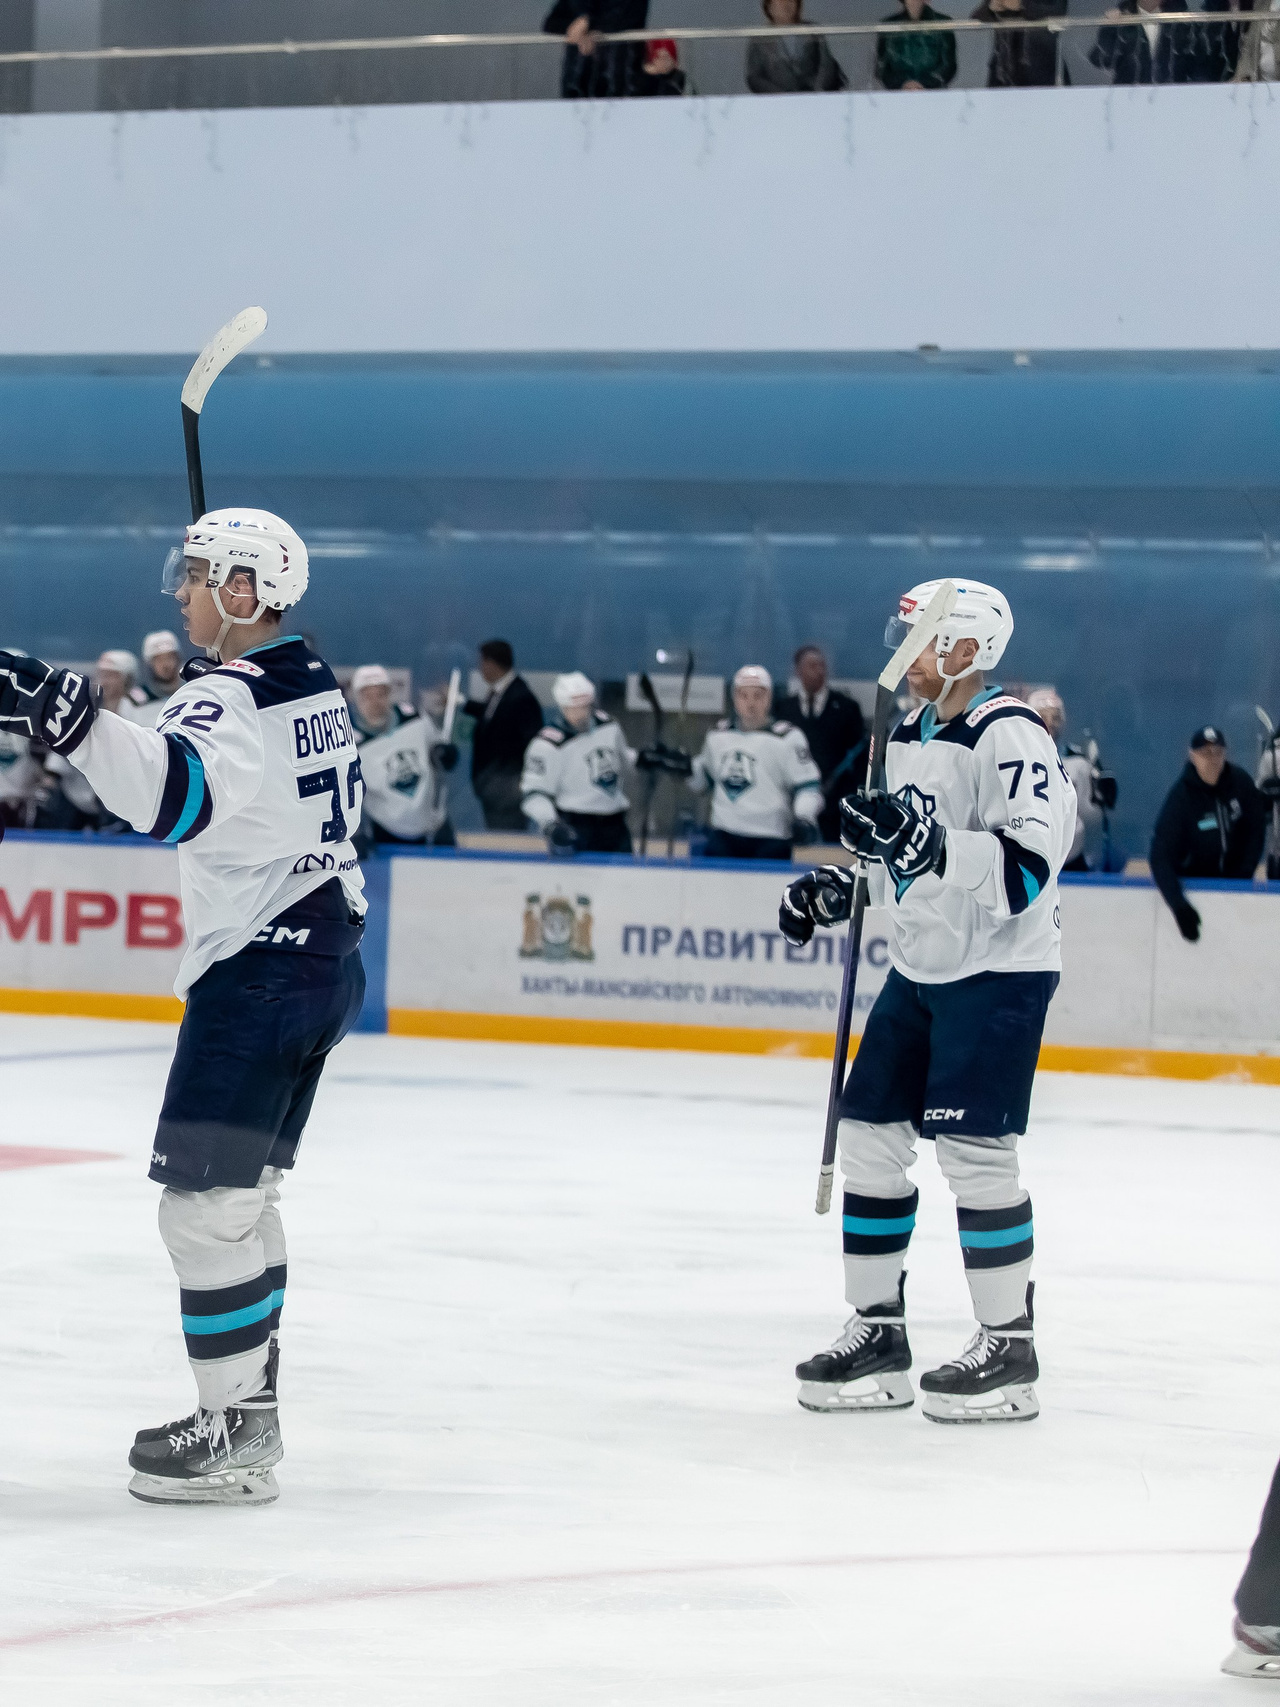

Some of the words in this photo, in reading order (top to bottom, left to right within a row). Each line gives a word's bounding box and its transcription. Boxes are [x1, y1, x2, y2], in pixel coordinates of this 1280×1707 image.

[228, 549, 260, 559] CCM
[188, 662, 207, 674] CCM
[293, 706, 354, 759] BORISO
[998, 760, 1050, 803] 72
[923, 1108, 966, 1121] CCM
